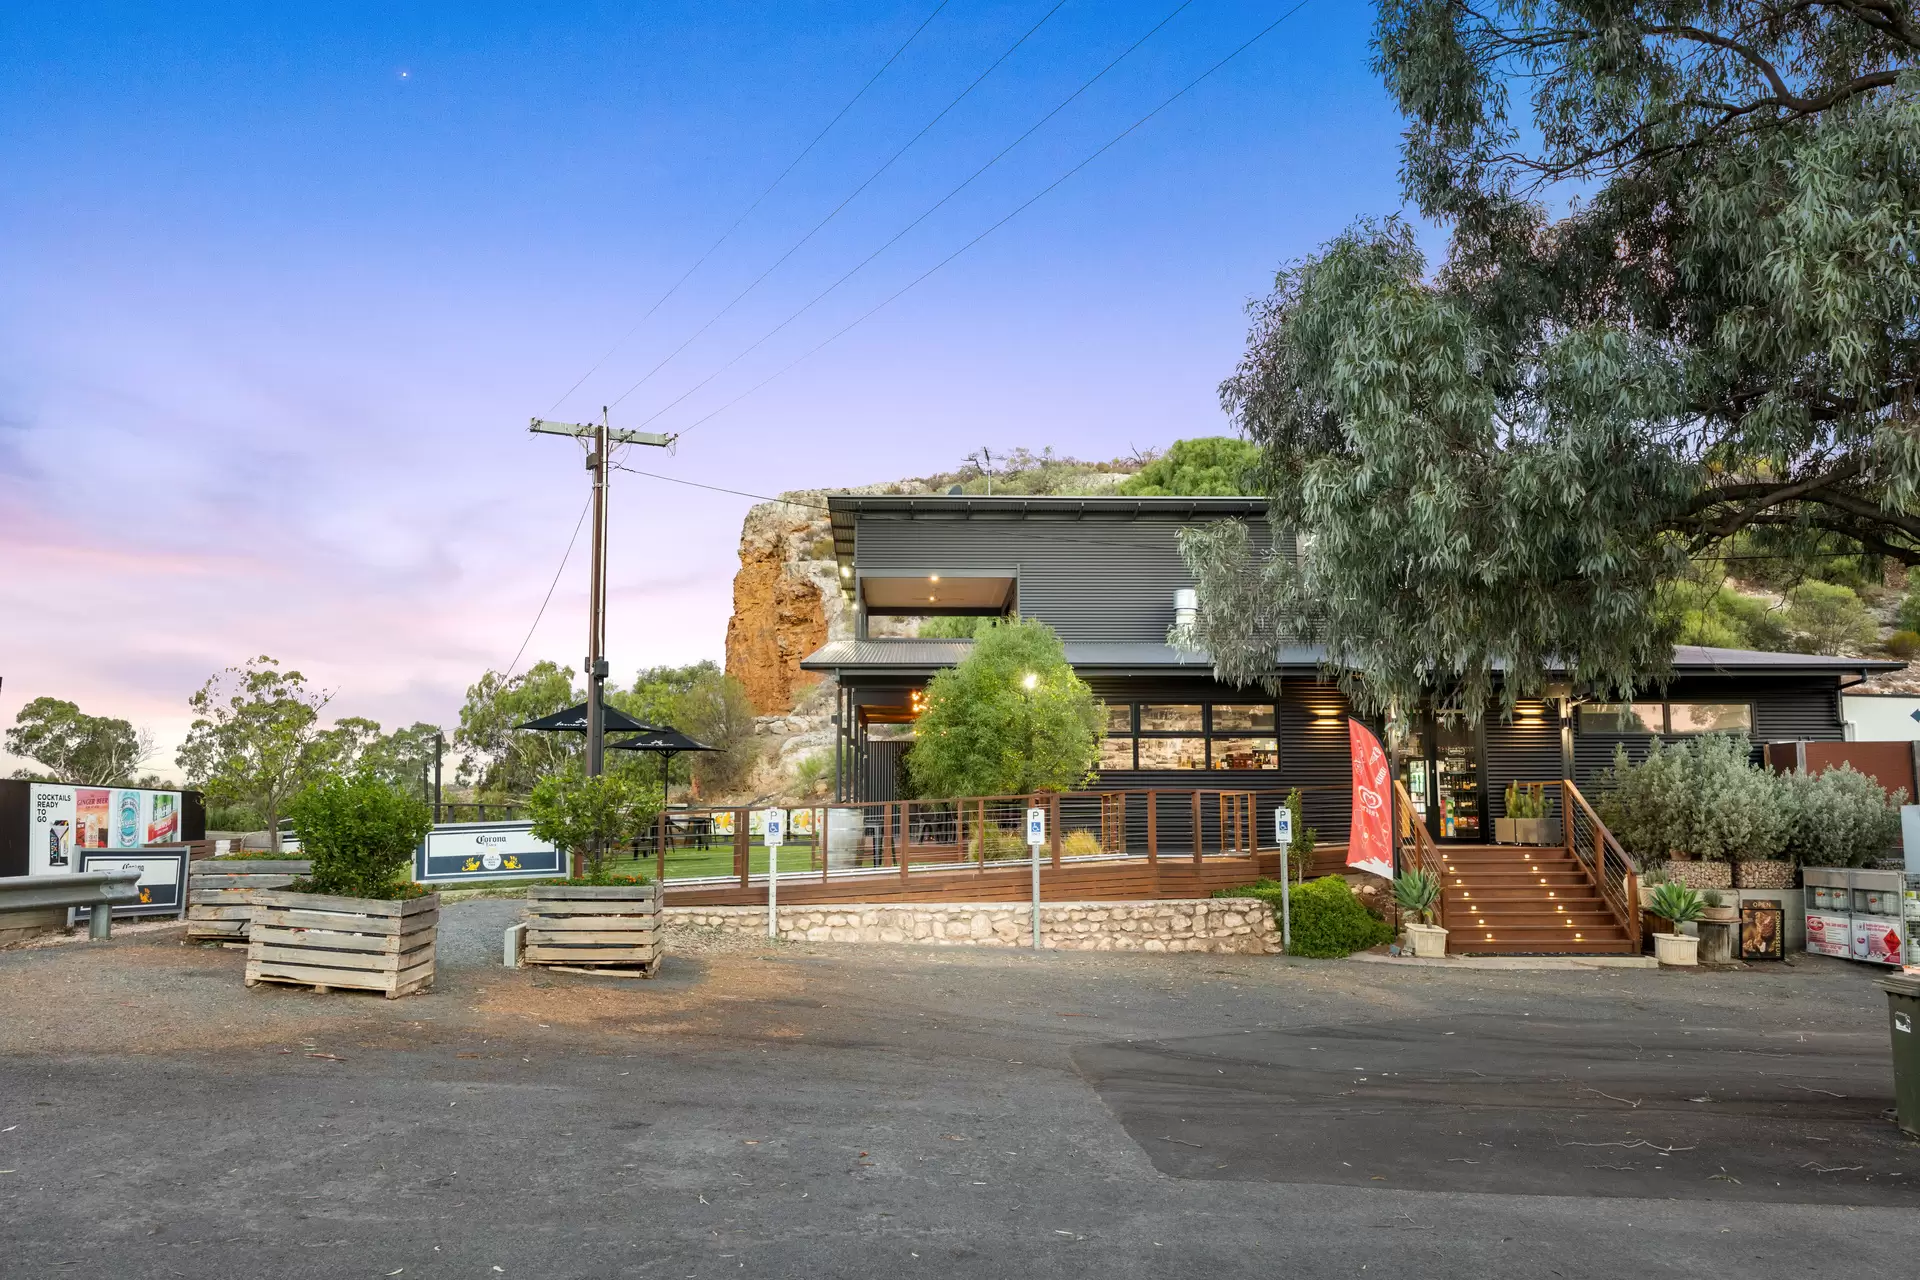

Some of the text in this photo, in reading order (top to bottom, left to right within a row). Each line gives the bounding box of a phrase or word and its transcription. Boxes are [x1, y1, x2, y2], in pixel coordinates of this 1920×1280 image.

[37, 794, 71, 802] COCKTAILS
[771, 811, 777, 820] P
[1033, 811, 1039, 819] P
[476, 835, 507, 845] Corona
